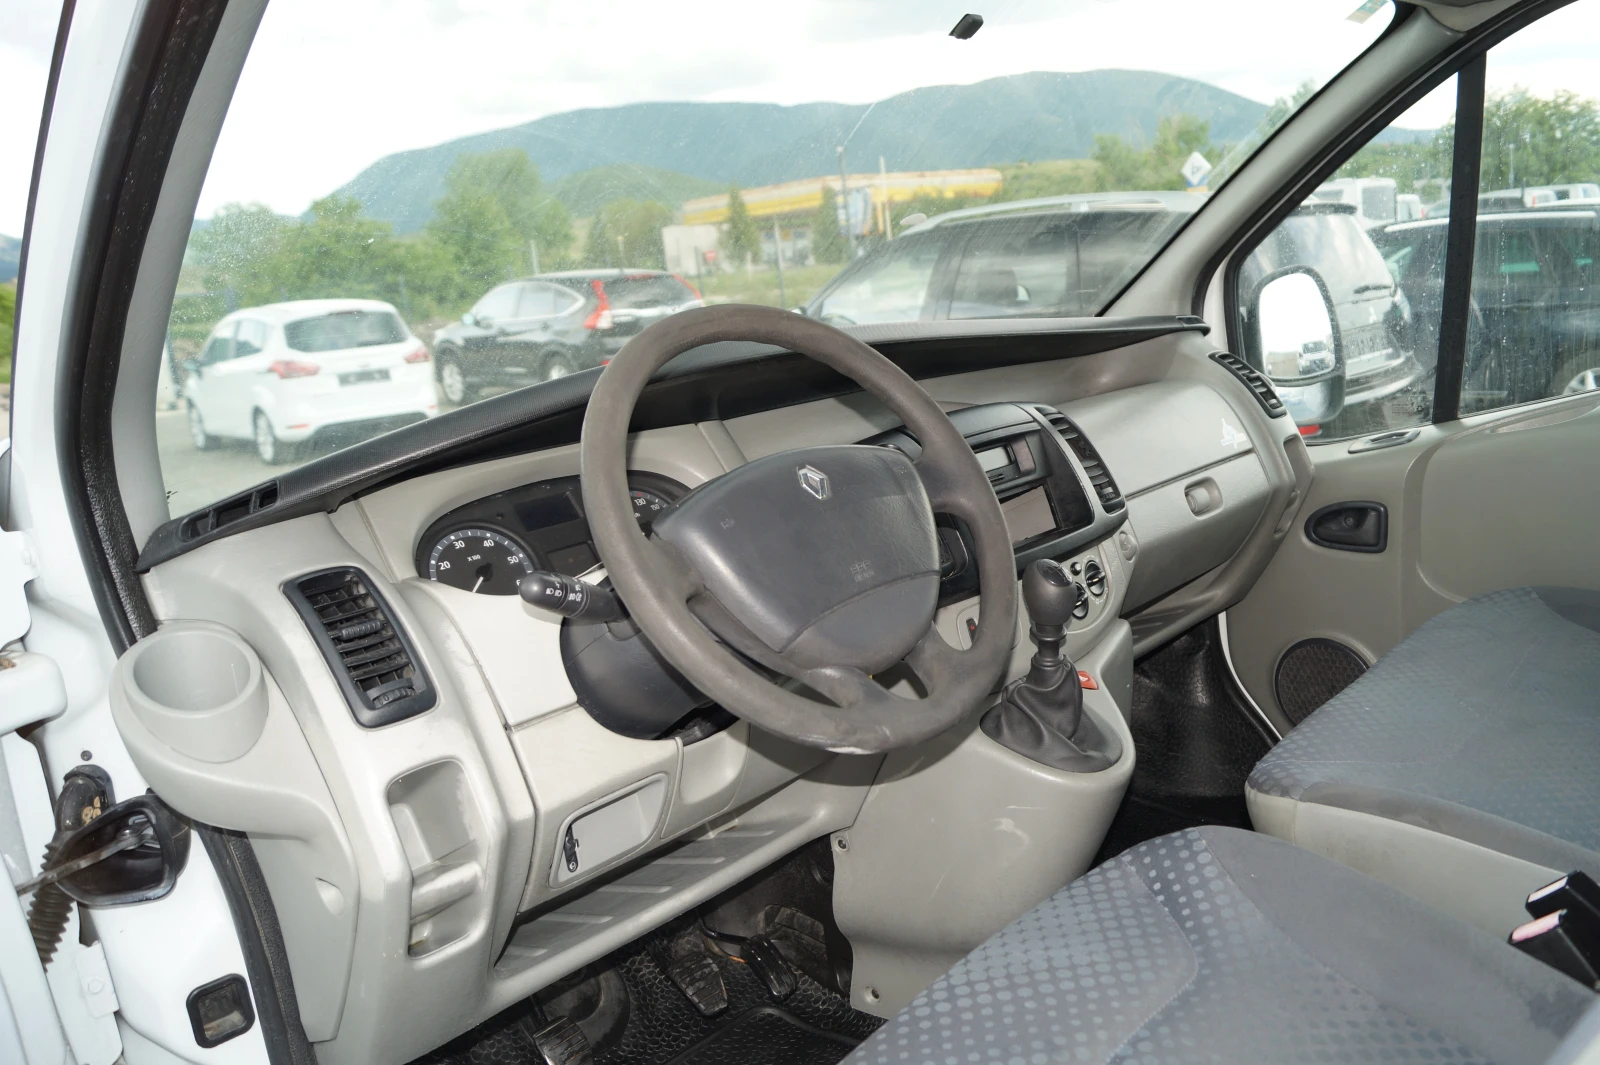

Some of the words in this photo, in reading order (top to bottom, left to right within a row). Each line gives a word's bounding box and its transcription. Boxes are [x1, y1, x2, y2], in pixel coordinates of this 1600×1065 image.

[634, 498, 646, 506] 130
[453, 540, 465, 549] 30
[483, 539, 495, 548] 40
[507, 556, 519, 564] 50
[438, 561, 451, 570] 20
